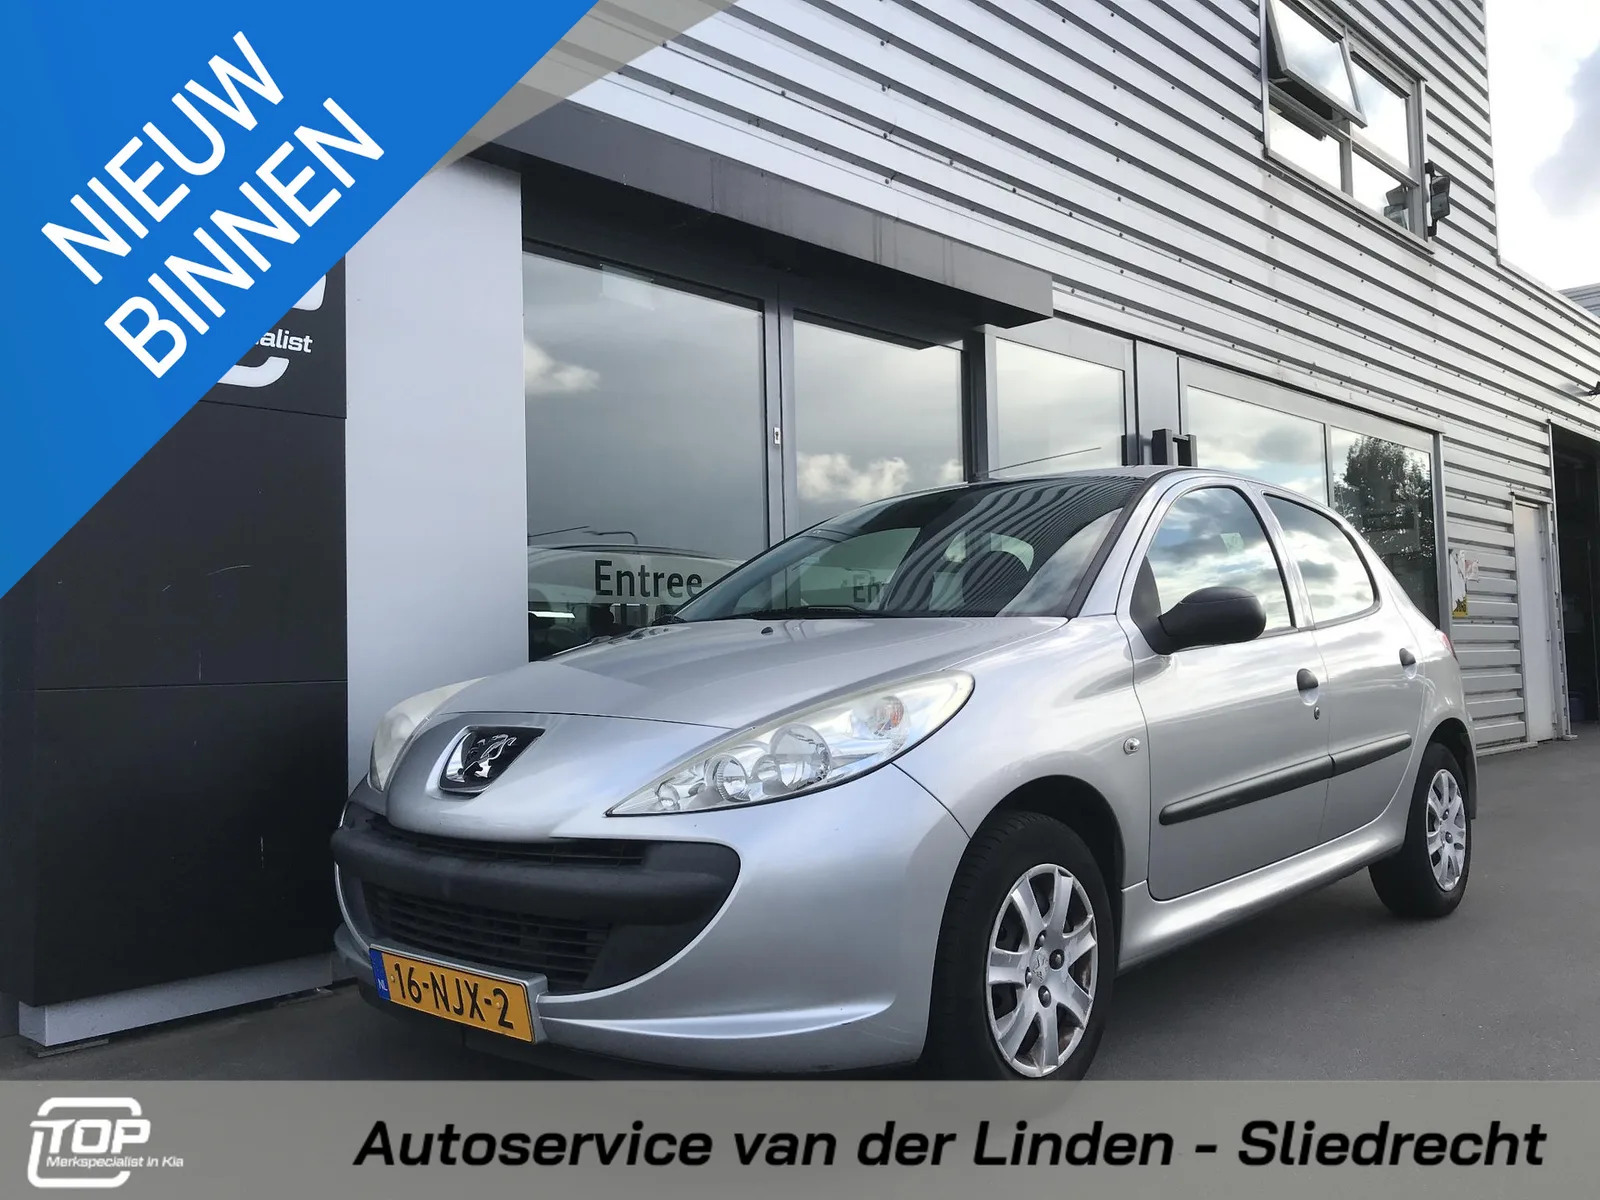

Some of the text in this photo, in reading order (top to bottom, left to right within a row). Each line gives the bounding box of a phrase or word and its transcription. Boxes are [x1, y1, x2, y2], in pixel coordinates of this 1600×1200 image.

[595, 559, 702, 598] Entree
[377, 978, 388, 992] NL
[394, 962, 514, 1030] 16-NJX-2
